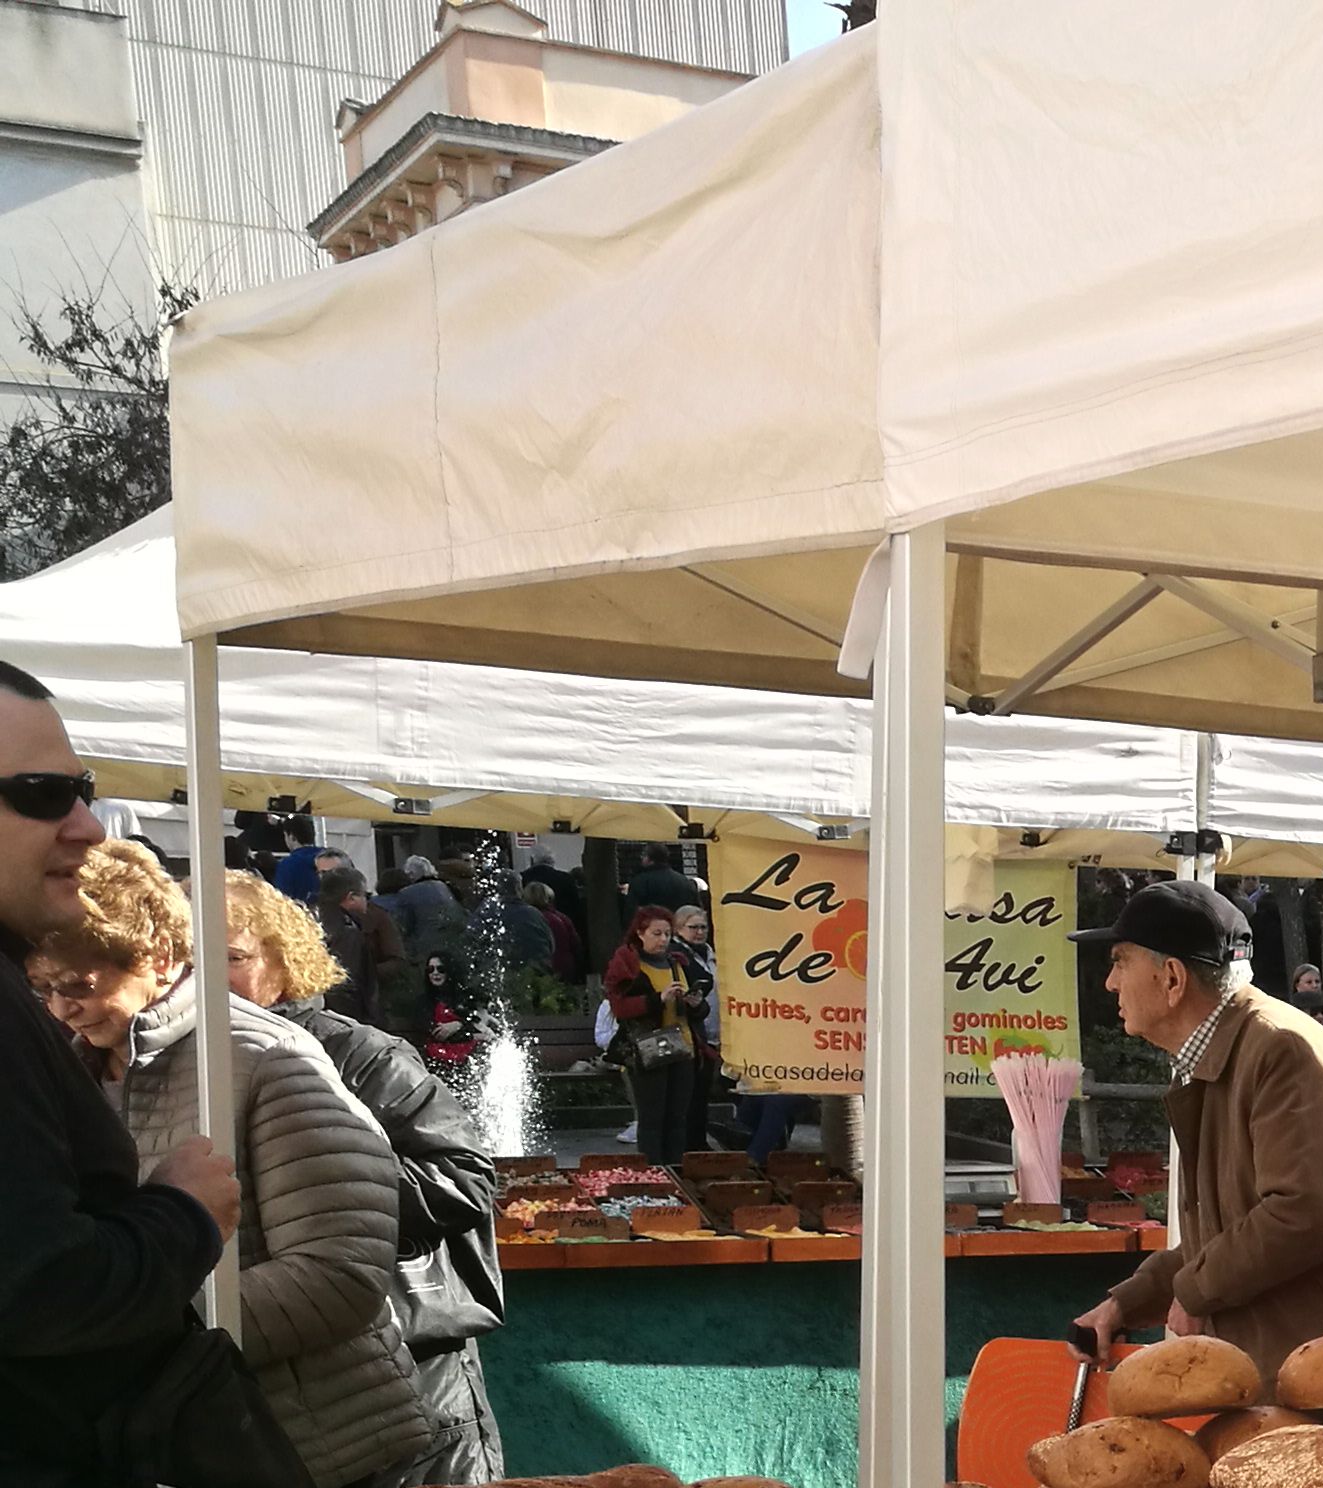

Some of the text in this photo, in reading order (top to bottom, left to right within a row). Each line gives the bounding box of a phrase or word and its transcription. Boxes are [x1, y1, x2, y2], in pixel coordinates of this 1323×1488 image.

[720, 852, 845, 914] La
[744, 932, 837, 984] de
[727, 996, 812, 1024] Fruites,
[953, 1008, 1068, 1033] gominoles
[814, 1029, 987, 1055] SEN TEN
[743, 1058, 864, 1082] lacasadela
